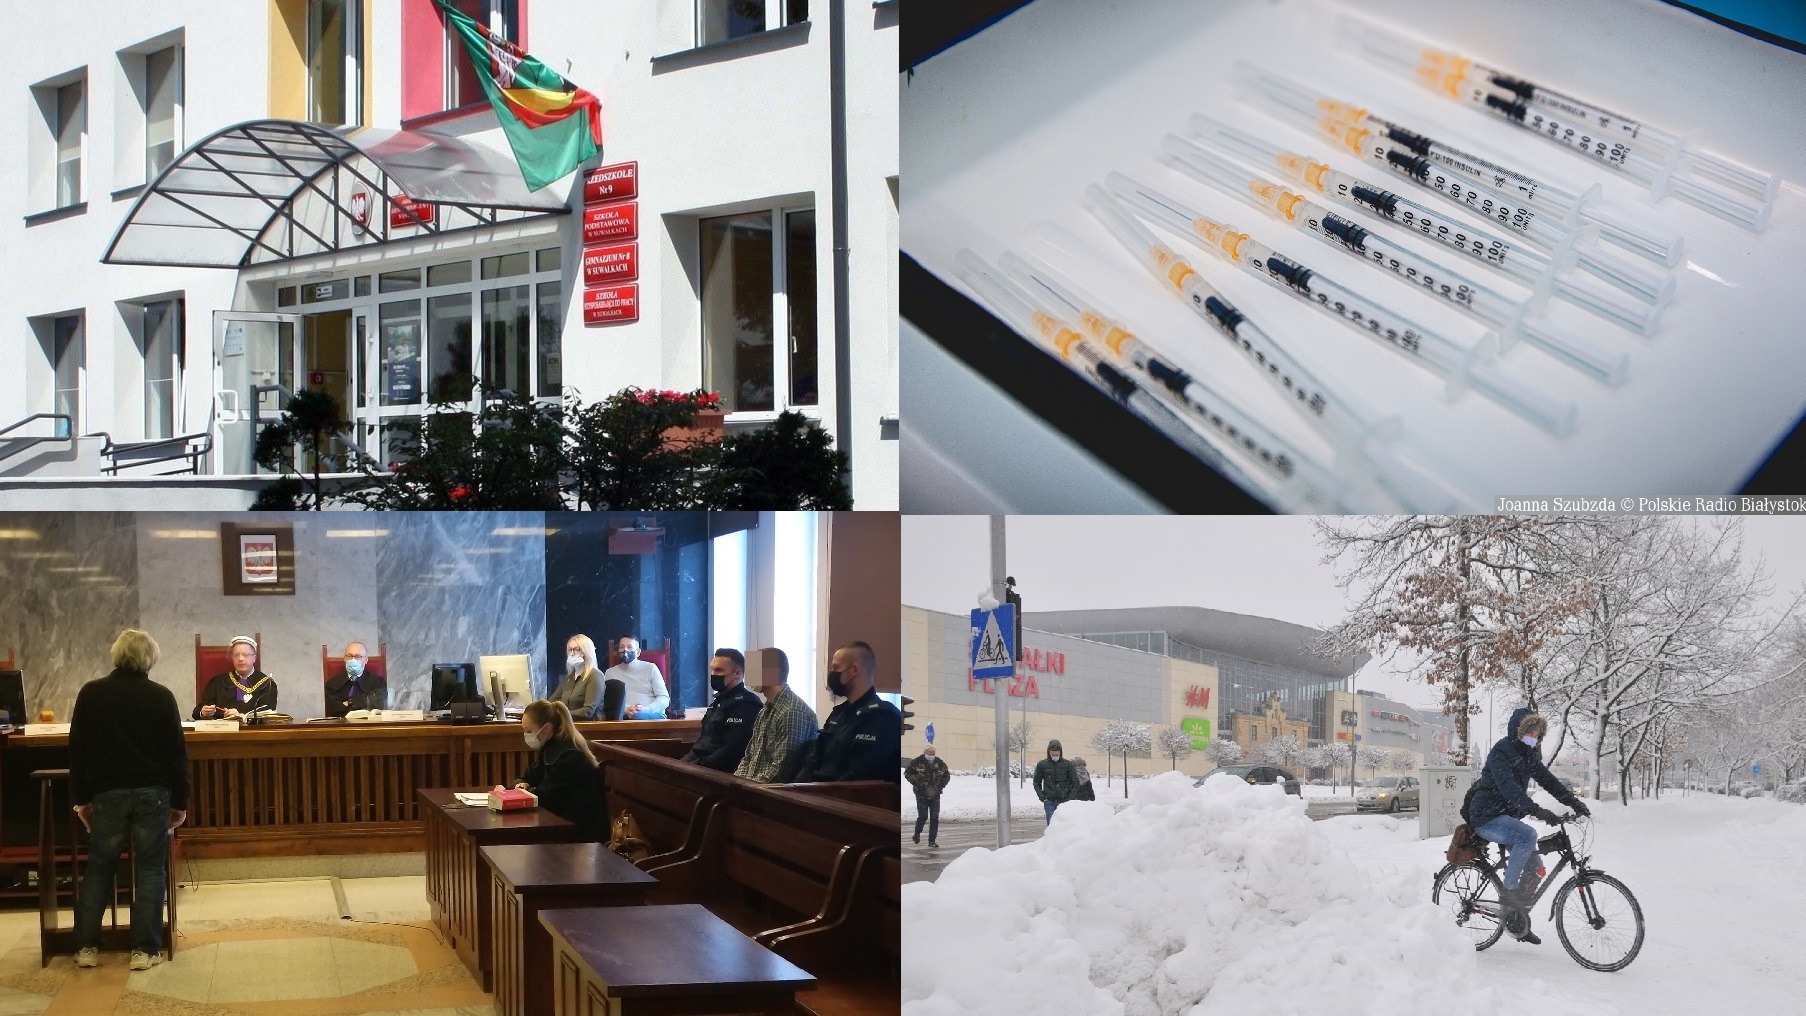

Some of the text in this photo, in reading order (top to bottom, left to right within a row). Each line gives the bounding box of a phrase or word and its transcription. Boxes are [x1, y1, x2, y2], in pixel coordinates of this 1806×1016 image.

[1533, 115, 1544, 129] 50
[1548, 122, 1559, 136] 60
[1563, 128, 1575, 143] 70
[1579, 136, 1591, 150] 80
[1374, 147, 1384, 160] 10
[1595, 142, 1607, 157] 90
[1610, 143, 1625, 163] 100
[1454, 160, 1482, 177] INSULIN
[599, 184, 613, 195] Nr 9
[1338, 183, 1347, 197] 10
[1434, 175, 1445, 190] 50
[1450, 183, 1461, 199] 60
[1466, 191, 1477, 206] 70
[1481, 199, 1493, 215] 80
[1402, 211, 1414, 226] 50
[1497, 207, 1509, 223] 90
[1512, 208, 1527, 228] 100
[584, 218, 630, 231] PODSTAWOWA
[1420, 218, 1431, 234] 60
[1437, 225, 1448, 240] 70
[1454, 233, 1466, 249] 80
[1472, 240, 1484, 256] 90
[1487, 240, 1502, 261] 100
[585, 252, 618, 266] GIMNAZJUM
[618, 252, 626, 261] Nr
